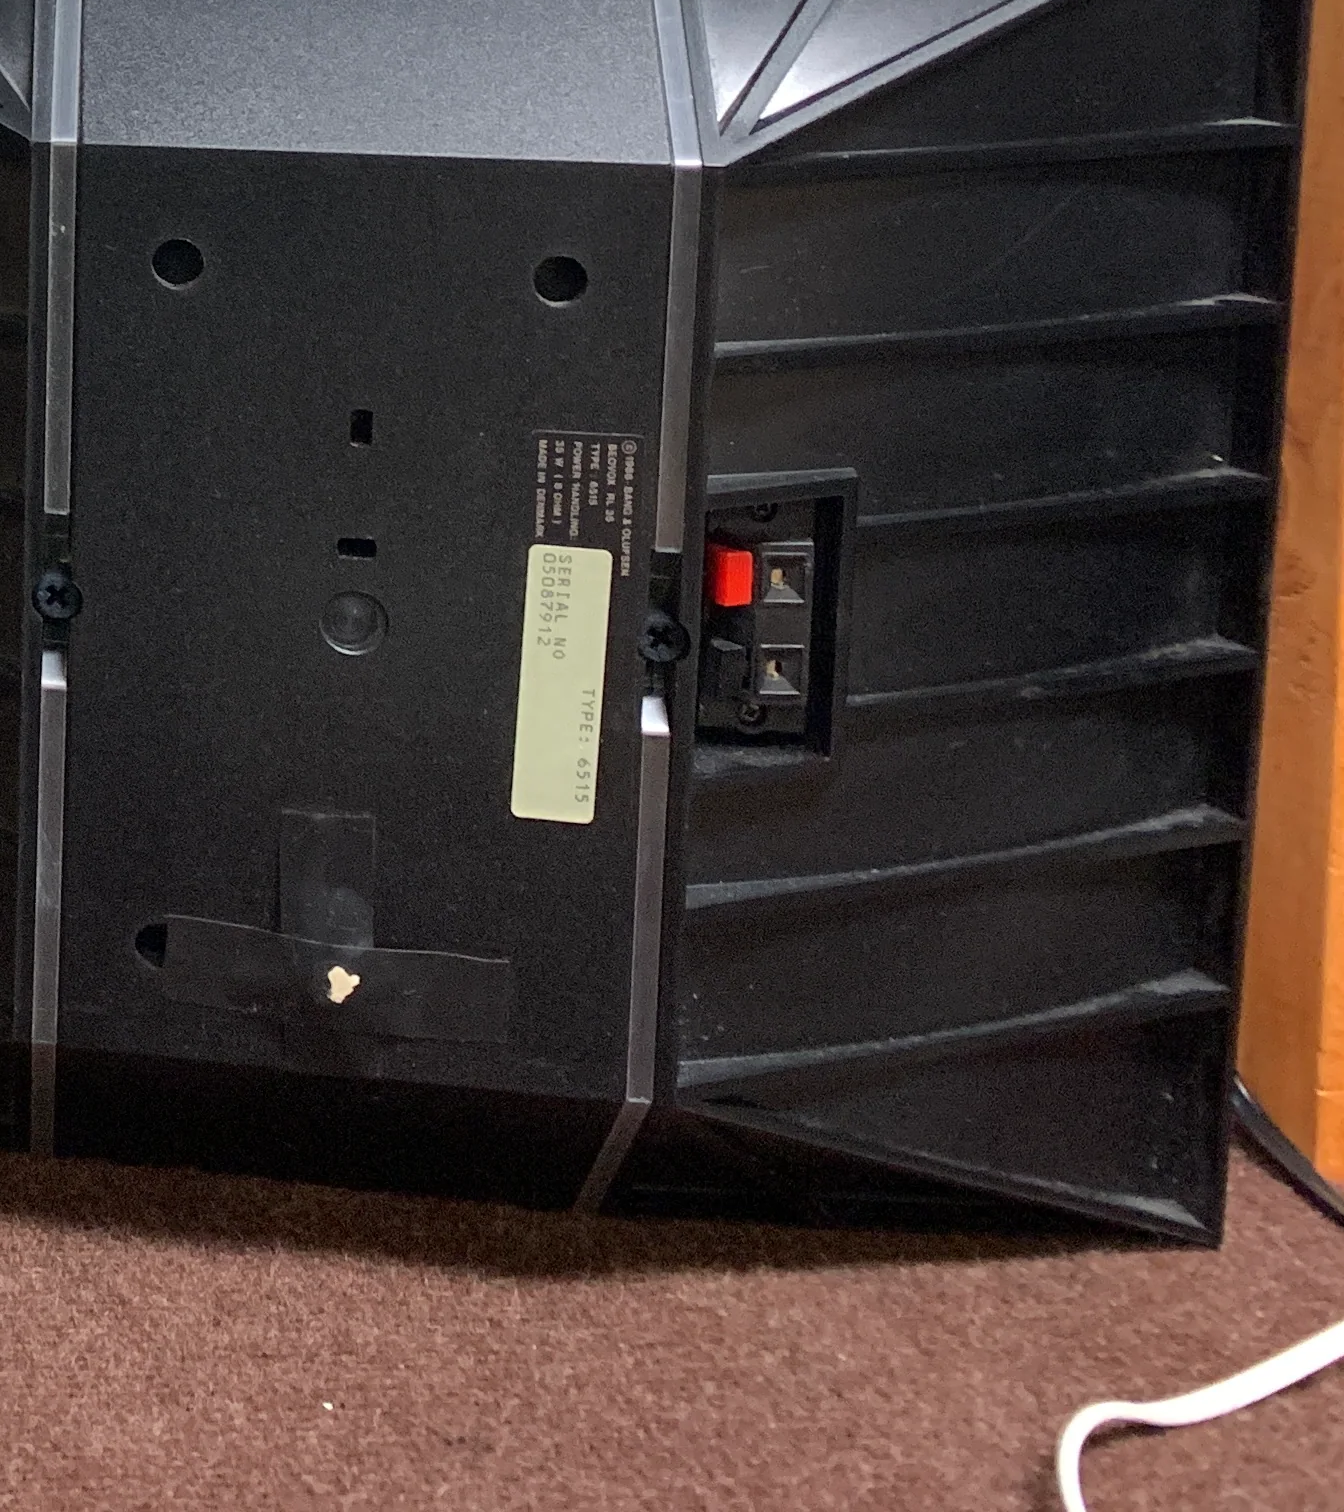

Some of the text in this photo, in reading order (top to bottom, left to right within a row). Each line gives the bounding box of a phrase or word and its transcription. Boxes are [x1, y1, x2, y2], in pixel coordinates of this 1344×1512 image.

[535, 439, 548, 538] MADE IN DENMARK
[572, 441, 583, 479] POWER
[607, 443, 618, 486] BEOVOX
[537, 552, 557, 646] 05087912
[620, 528, 632, 577] OLUFSEN
[552, 554, 572, 660] SERIAL NO
[574, 689, 595, 803] TYPE: 6515
